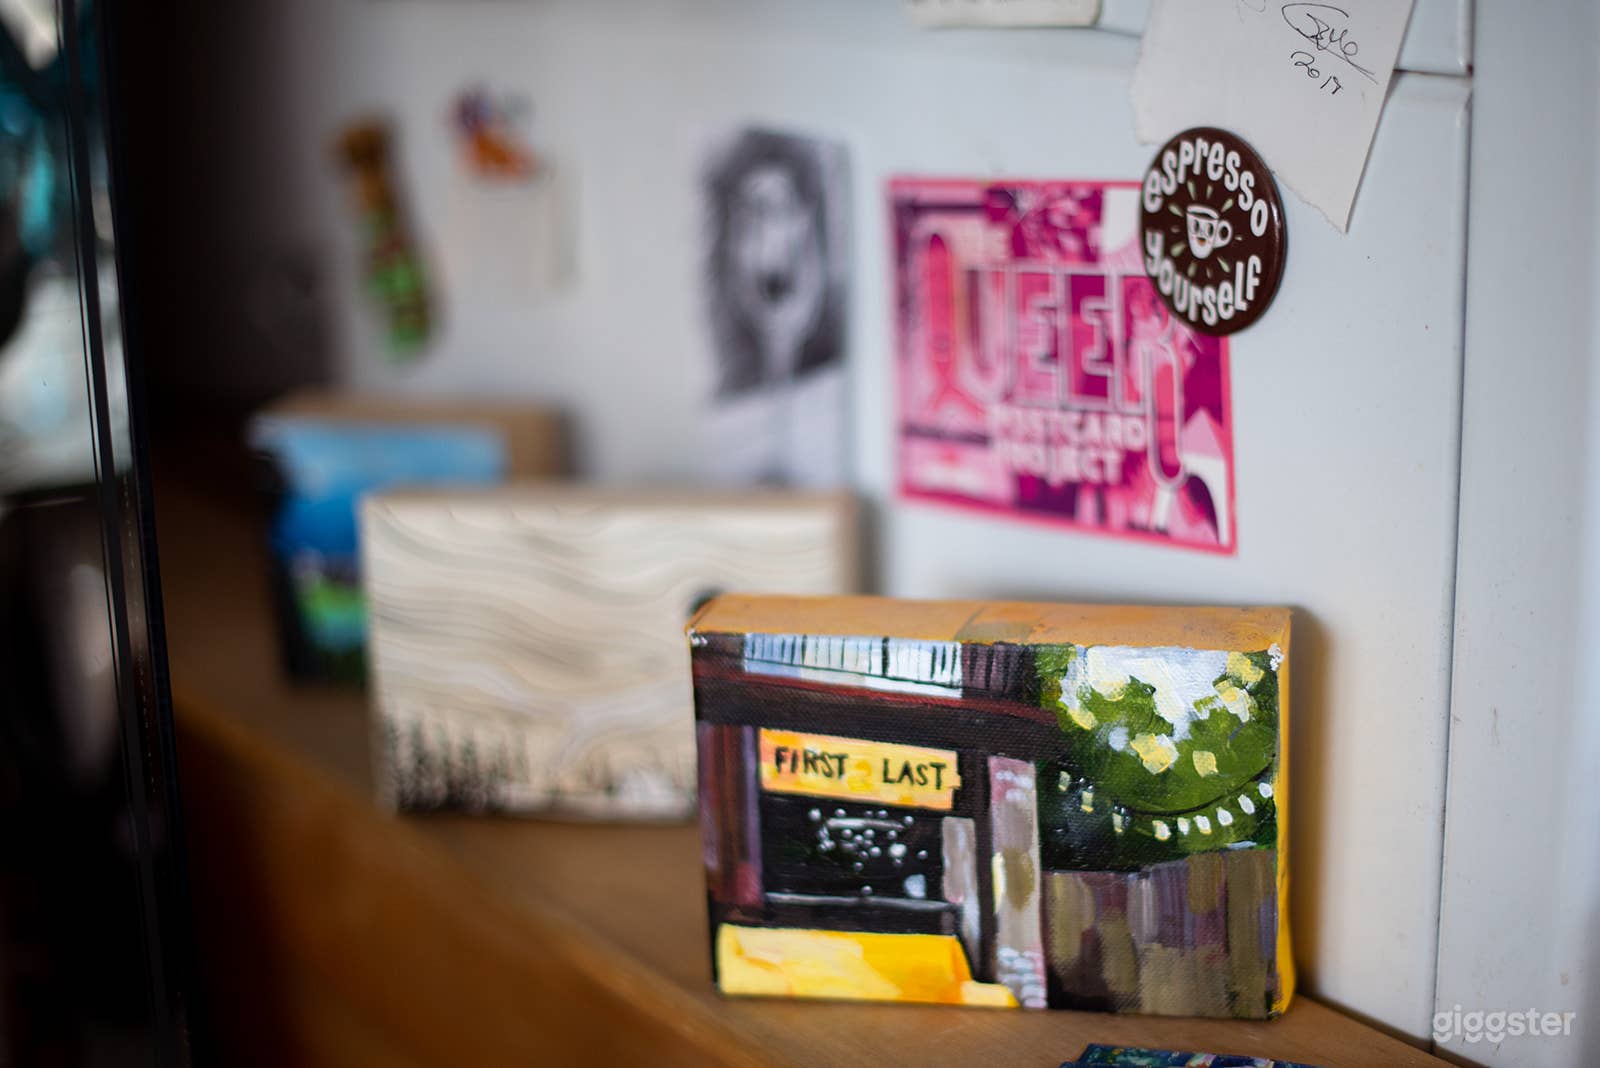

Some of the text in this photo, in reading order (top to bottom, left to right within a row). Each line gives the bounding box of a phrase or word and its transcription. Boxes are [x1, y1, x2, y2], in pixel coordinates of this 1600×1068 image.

[1143, 137, 1269, 237] espresso
[1145, 229, 1262, 326] yourself
[774, 746, 946, 790] FIRST LAST
